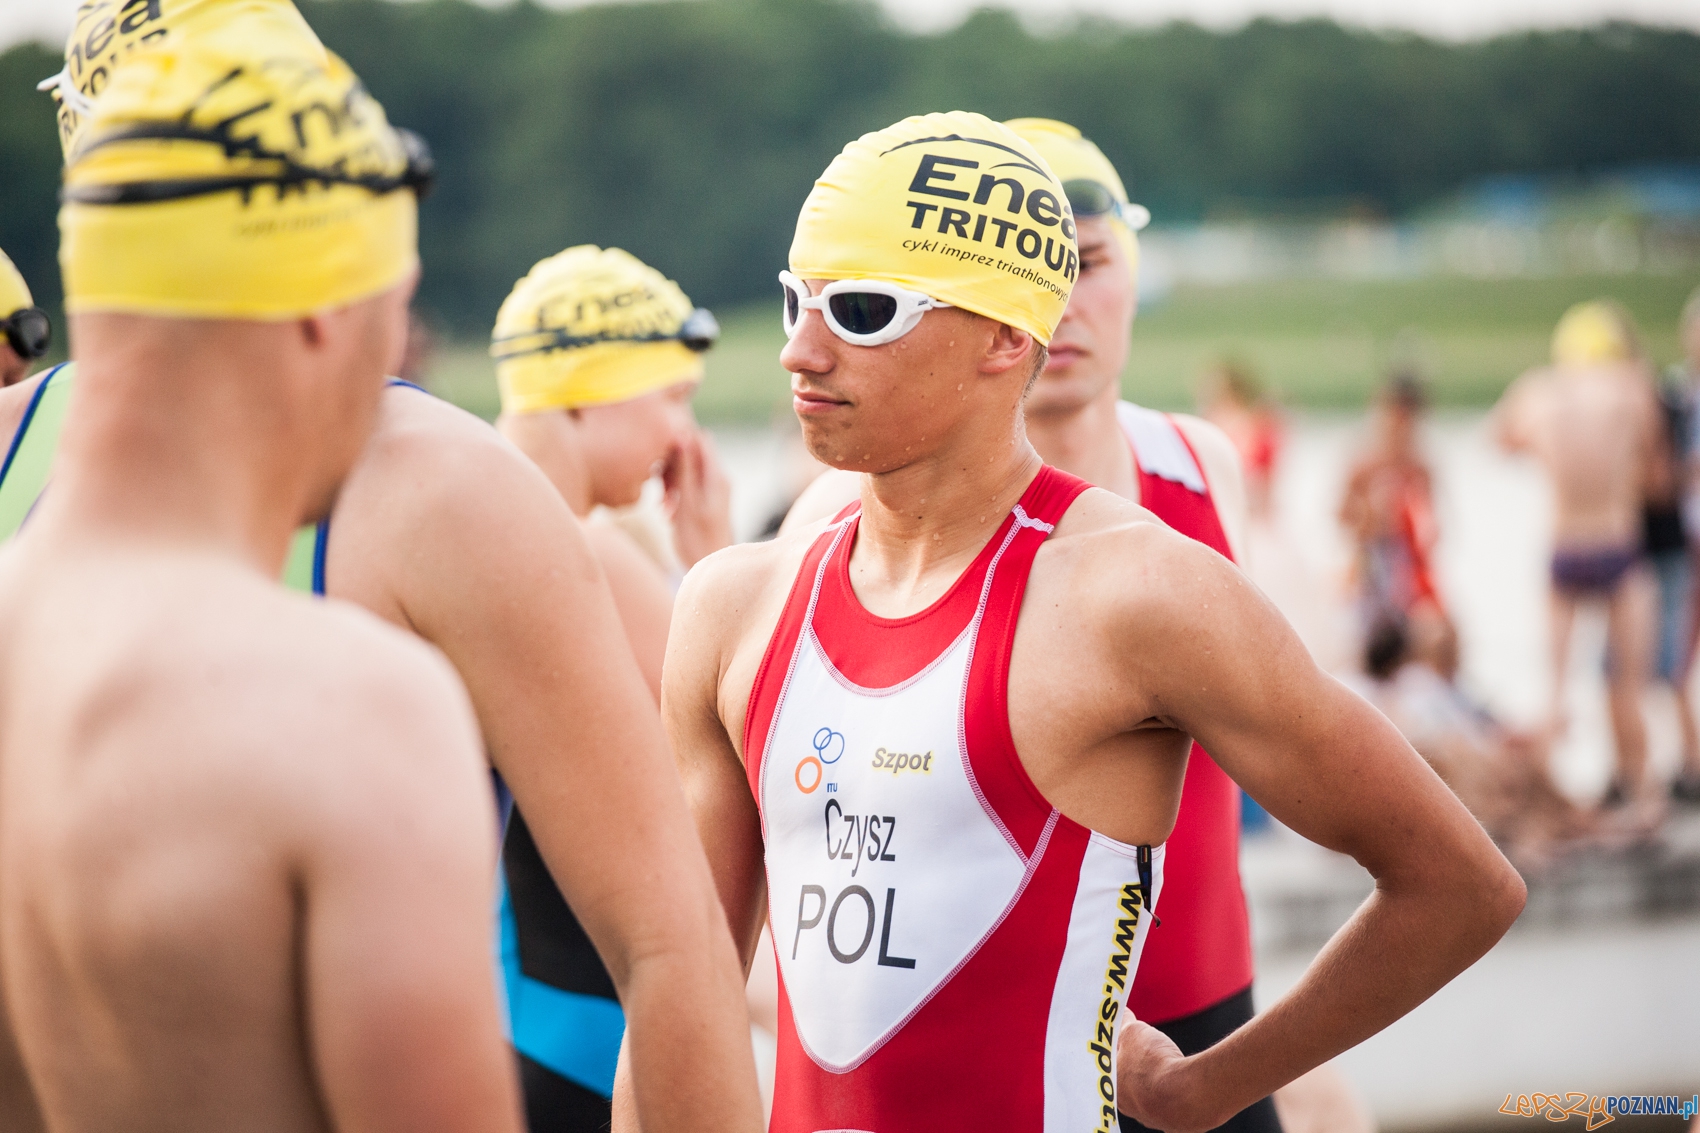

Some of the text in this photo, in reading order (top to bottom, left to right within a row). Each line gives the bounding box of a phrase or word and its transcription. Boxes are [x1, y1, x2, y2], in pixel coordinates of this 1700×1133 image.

[902, 238, 938, 255] cykl
[940, 242, 994, 268] imprez
[906, 200, 1079, 284] TRITOUR
[826, 782, 838, 793] ITU
[872, 747, 933, 774] Szpot
[824, 798, 896, 877] Czysz
[792, 884, 917, 970] POL
[1089, 884, 1143, 1133] www.szpot.
